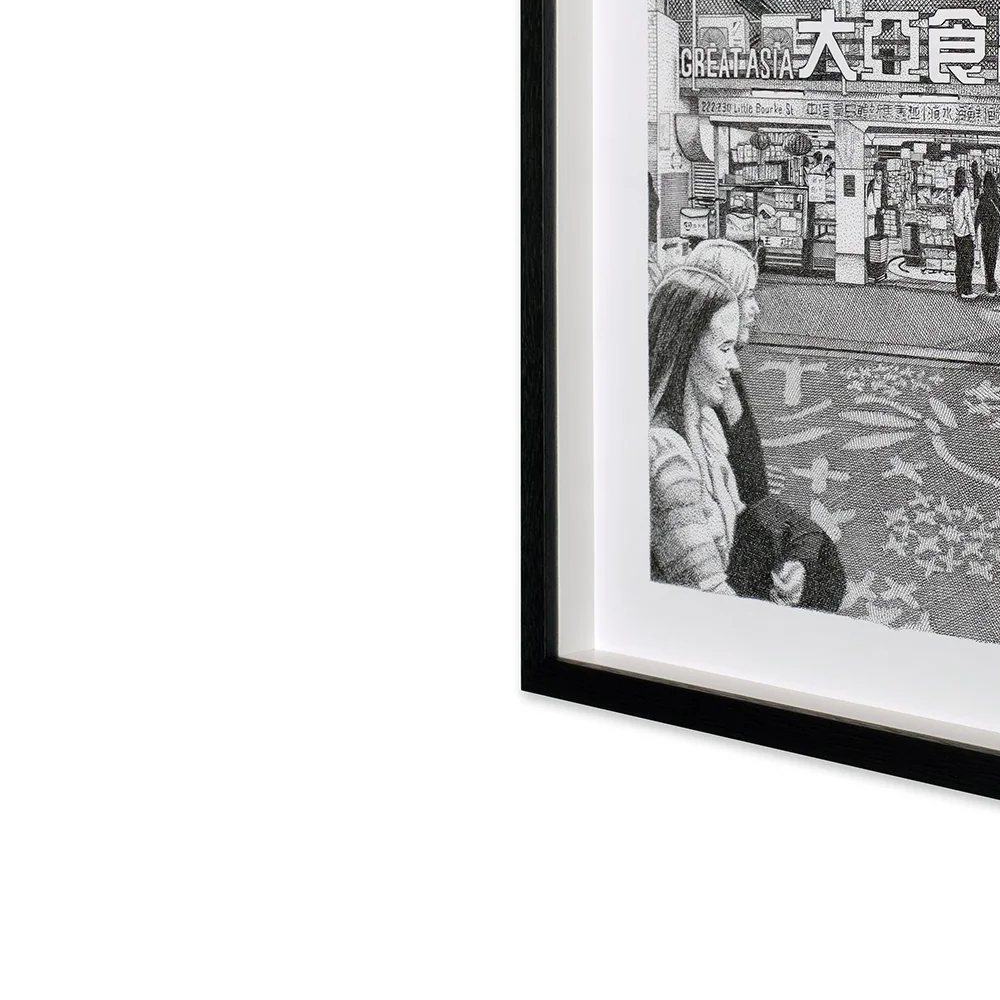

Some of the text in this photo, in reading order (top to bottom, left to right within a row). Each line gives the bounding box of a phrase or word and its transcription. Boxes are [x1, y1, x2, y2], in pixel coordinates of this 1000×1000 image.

[681, 47, 742, 78] GREAT
[746, 48, 794, 80] ASIA
[733, 103, 753, 114] Little
[755, 102, 783, 114] Bourke
[785, 103, 795, 116] St
